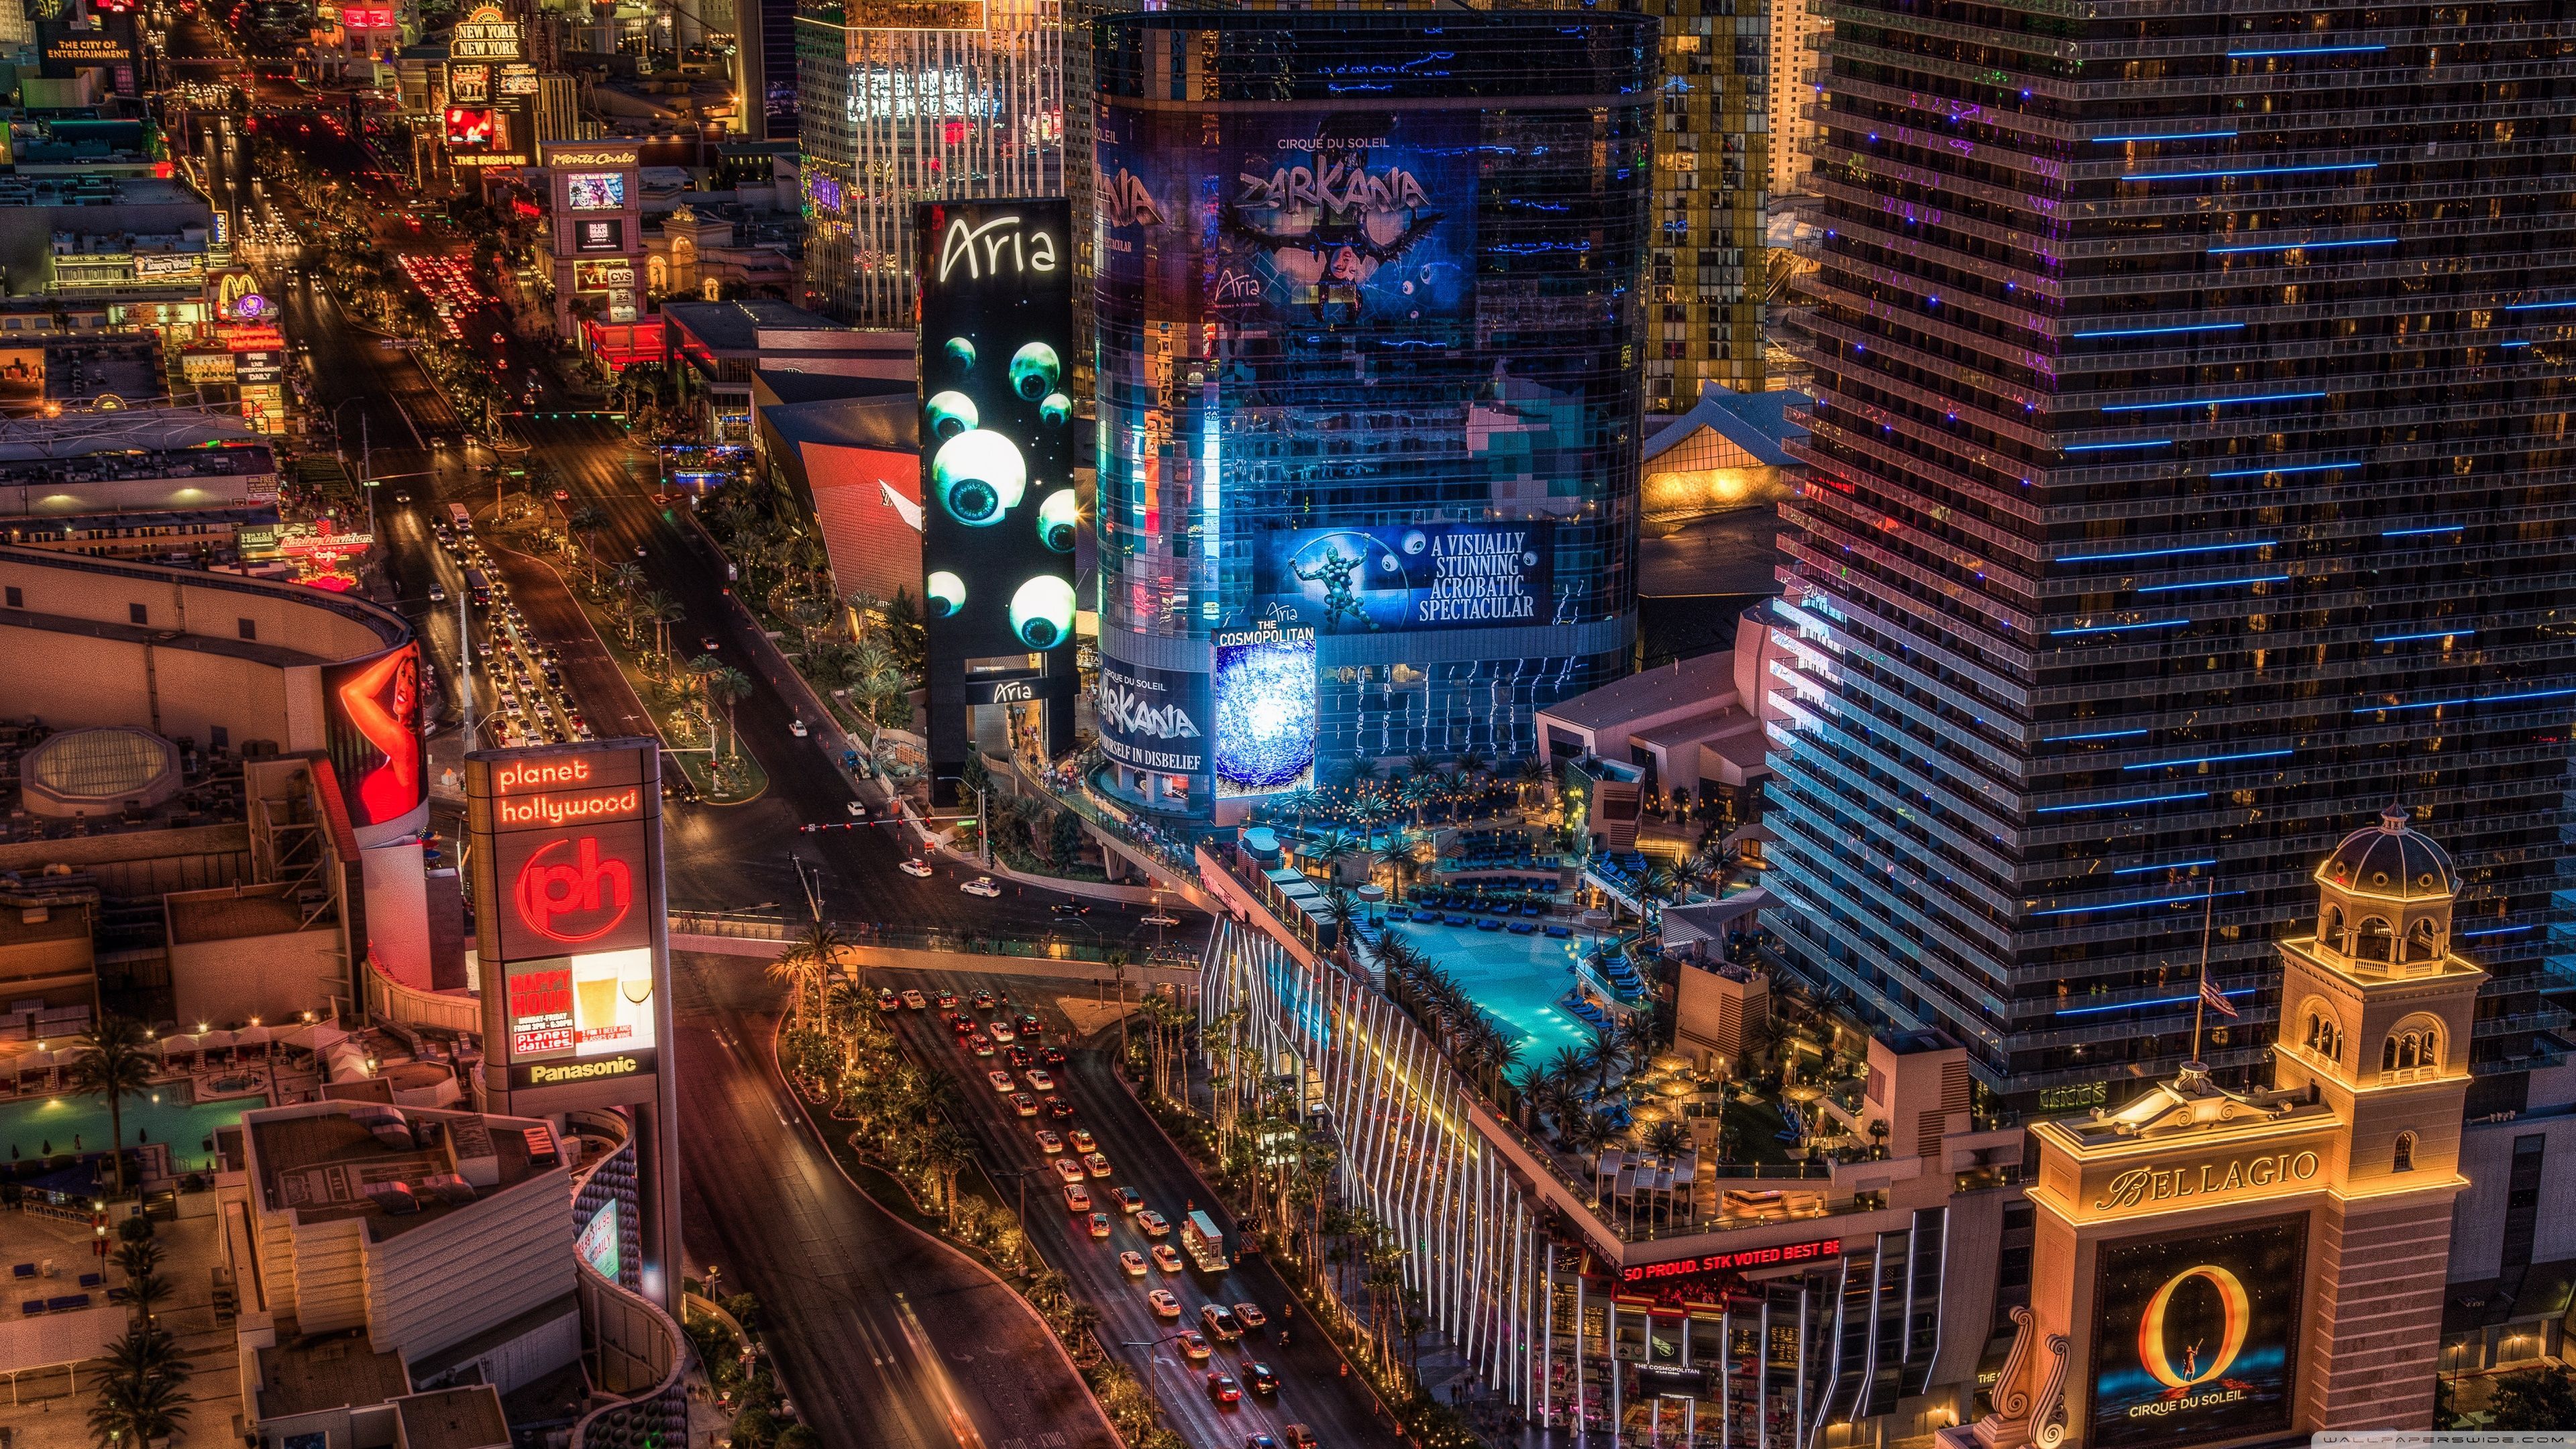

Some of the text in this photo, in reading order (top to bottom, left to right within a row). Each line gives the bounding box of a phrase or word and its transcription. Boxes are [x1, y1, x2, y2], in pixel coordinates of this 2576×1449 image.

[458, 25, 518, 39] NEW YORK
[48, 50, 129, 58] ENTERTAINMENT
[58, 40, 117, 49] THE CITY OF
[460, 42, 519, 55] NEW YORK
[1277, 138, 1390, 152] CIRQUE DU SOLEIL
[455, 155, 527, 165] THE IRISH PUB
[551, 152, 636, 166] Monte Carlo
[1233, 154, 1431, 220] ZARKANA
[940, 216, 1055, 282] Aria
[610, 272, 631, 281] CVS
[1215, 269, 1260, 302] Aria
[1431, 532, 1525, 557] A VISUALLY
[315, 551, 337, 562] Cafe
[1436, 553, 1519, 578] STUNNING
[1430, 575, 1524, 600] ACROBATIC
[1266, 602, 1298, 623] Aria
[1419, 596, 1534, 621] SPECTACULAR
[1220, 627, 1315, 646] COSMOPOLITAN
[1257, 621, 1277, 630] THE
[1104, 667, 1167, 692] CIRQUE DU SOLEIL
[994, 682, 1033, 704] Aria
[1132, 747, 1142, 763] IN
[1144, 750, 1201, 771] DISBELIEF
[500, 760, 588, 792] planet
[502, 790, 635, 823] hollywood
[510, 969, 571, 994] HAPPY
[511, 989, 572, 1018] HOUR
[514, 1024, 531, 1033] FROM
[532, 1022, 545, 1030] 3PM
[518, 1012, 568, 1024] MONDAY-FRIDAY
[531, 1056, 637, 1083] Panasonic
[2095, 1150, 2320, 1211] BELLAGIO
[1624, 1267, 1642, 1281] SO
[1646, 1260, 1700, 1279] PROUD.
[1703, 1254, 1732, 1271] STK
[1733, 1248, 1780, 1267] VOTED
[1783, 1243, 1821, 1260] BEST
[1649, 1364, 1700, 1375] COSMOPOLITAN
[1978, 1373, 1996, 1384] THE
[2129, 1401, 2177, 1419] CIRQUE
[2180, 1397, 2198, 1410] DU
